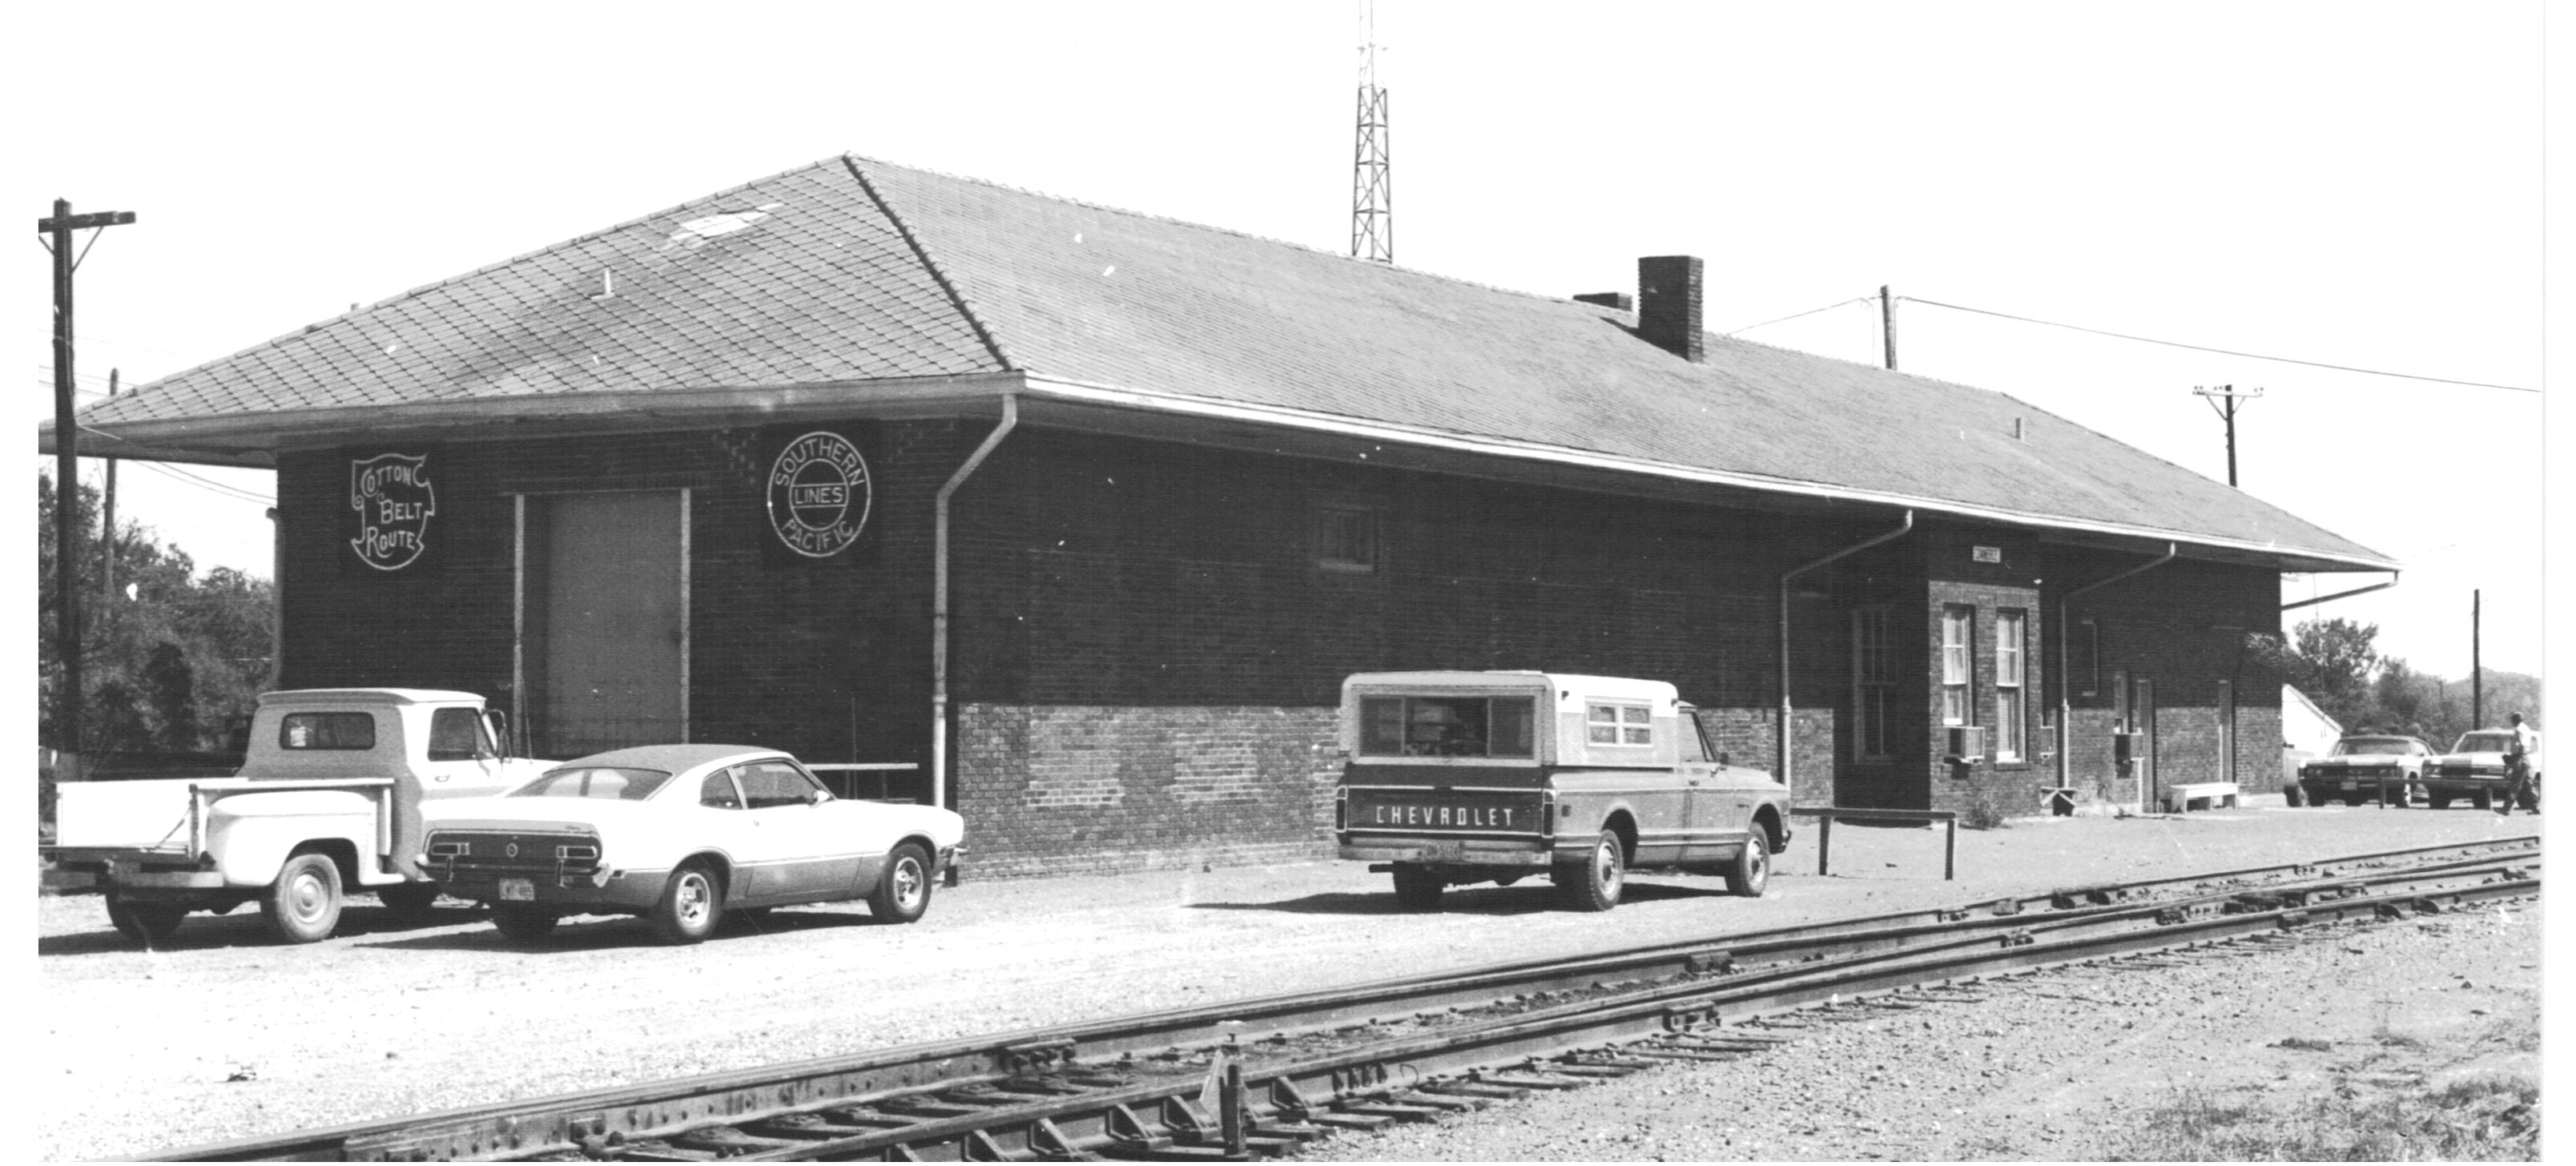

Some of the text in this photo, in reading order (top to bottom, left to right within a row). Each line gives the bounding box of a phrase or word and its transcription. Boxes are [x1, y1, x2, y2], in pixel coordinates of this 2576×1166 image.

[775, 438, 865, 486] SOUTHERN
[361, 465, 412, 497] COTTON
[795, 487, 843, 505] LINES
[376, 493, 422, 524] BELT
[366, 526, 415, 558] ROUTE
[782, 519, 853, 551] PACIFIC
[1376, 806, 1512, 826] CHEVROLET
